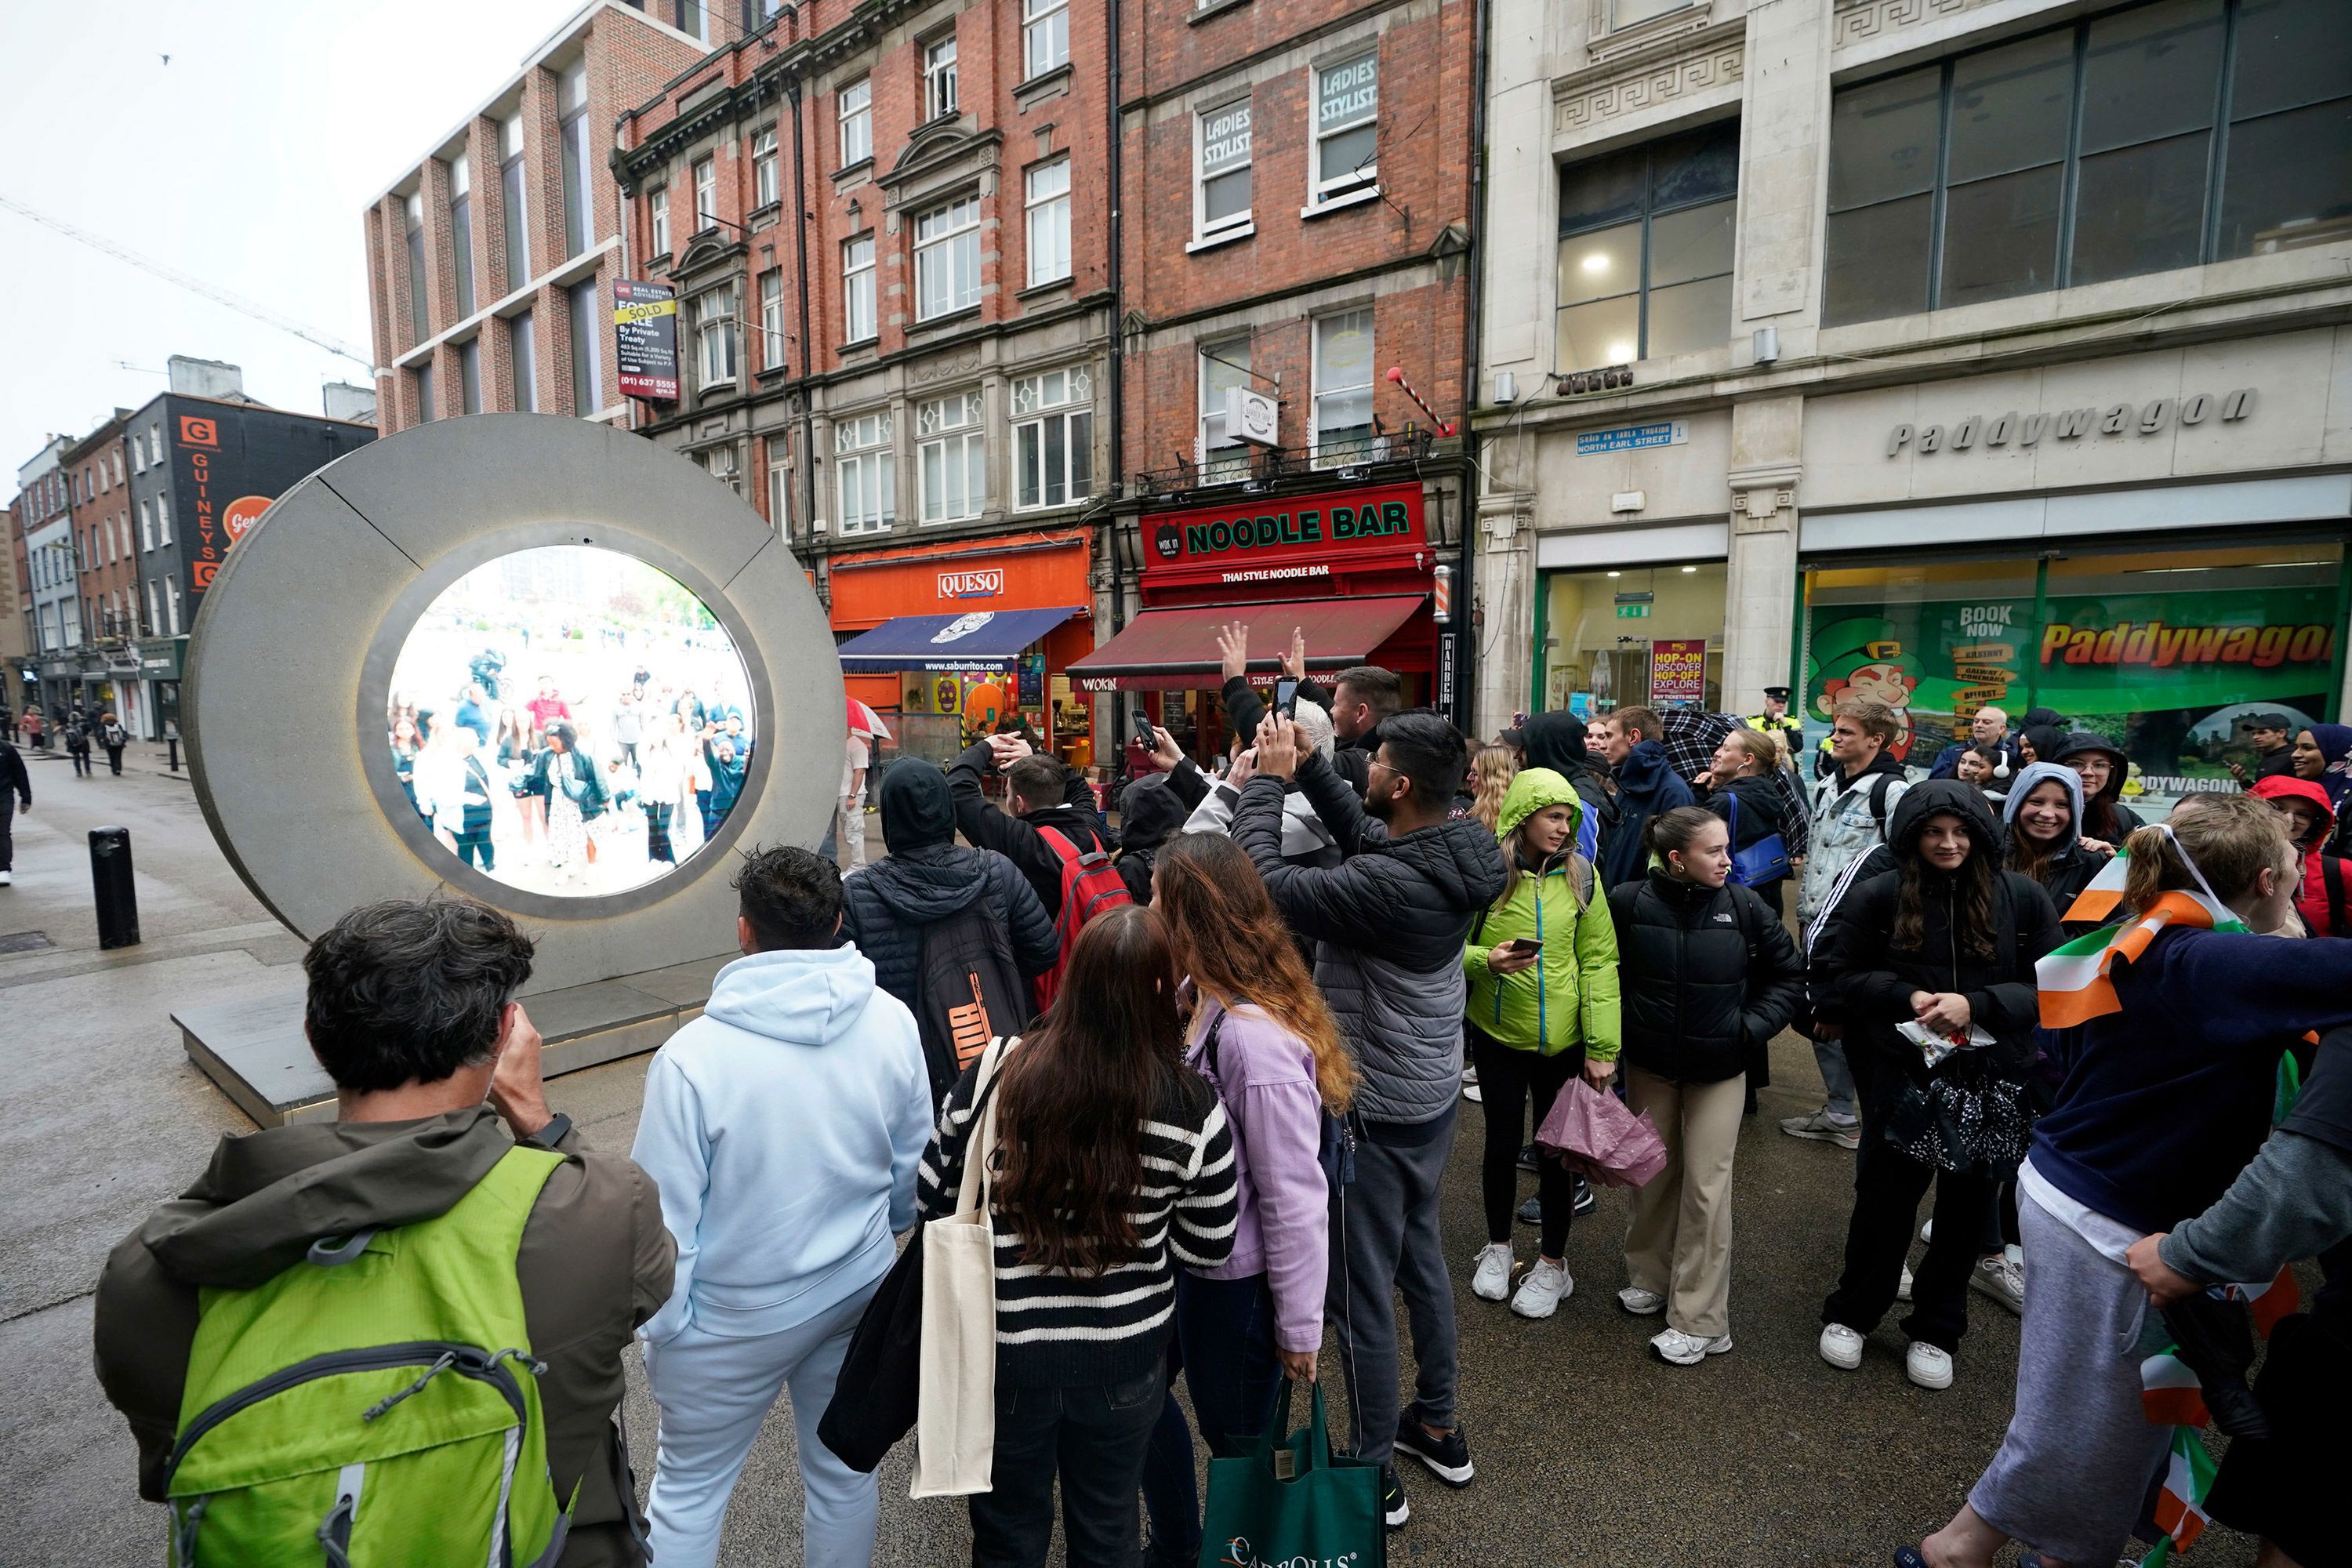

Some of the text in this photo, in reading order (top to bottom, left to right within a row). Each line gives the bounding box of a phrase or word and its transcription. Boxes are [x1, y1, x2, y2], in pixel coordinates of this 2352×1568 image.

[1323, 60, 1374, 96] LADIES
[1321, 85, 1376, 122] STYLIST
[1206, 108, 1250, 141] LADIES
[1204, 132, 1251, 166] STYLIST
[651, 288, 672, 297] ESTATE
[629, 305, 662, 319] SOLD
[619, 325, 659, 336] By Private
[619, 334, 645, 345] Treaty
[621, 376, 637, 385] (01)
[1888, 387, 2258, 456] Paddywagon
[187, 422, 209, 441] G
[1676, 426, 1682, 437] 1
[1578, 434, 1670, 452] NORTH EARL STREET
[191, 453, 216, 559] GUINEYS
[1185, 501, 1410, 554] NOODLE BAR
[1221, 565, 1330, 583] THAI STYLE NOODLE BAR
[942, 573, 999, 597] QUESO
[1960, 605, 2013, 626] BOOK
[1966, 622, 2004, 637] NOW
[1654, 653, 1702, 663] HOP-ON
[1965, 649, 2003, 659] KILKENNY
[925, 661, 1004, 670] www.saburritos.com
[1654, 662, 1701, 672] DISCOVER
[1252, 676, 1273, 685] STYLE
[1654, 671, 1700, 681] HOP-OFF
[1653, 679, 1700, 689] EXPLORE
[1964, 690, 1996, 699] BELFAST
